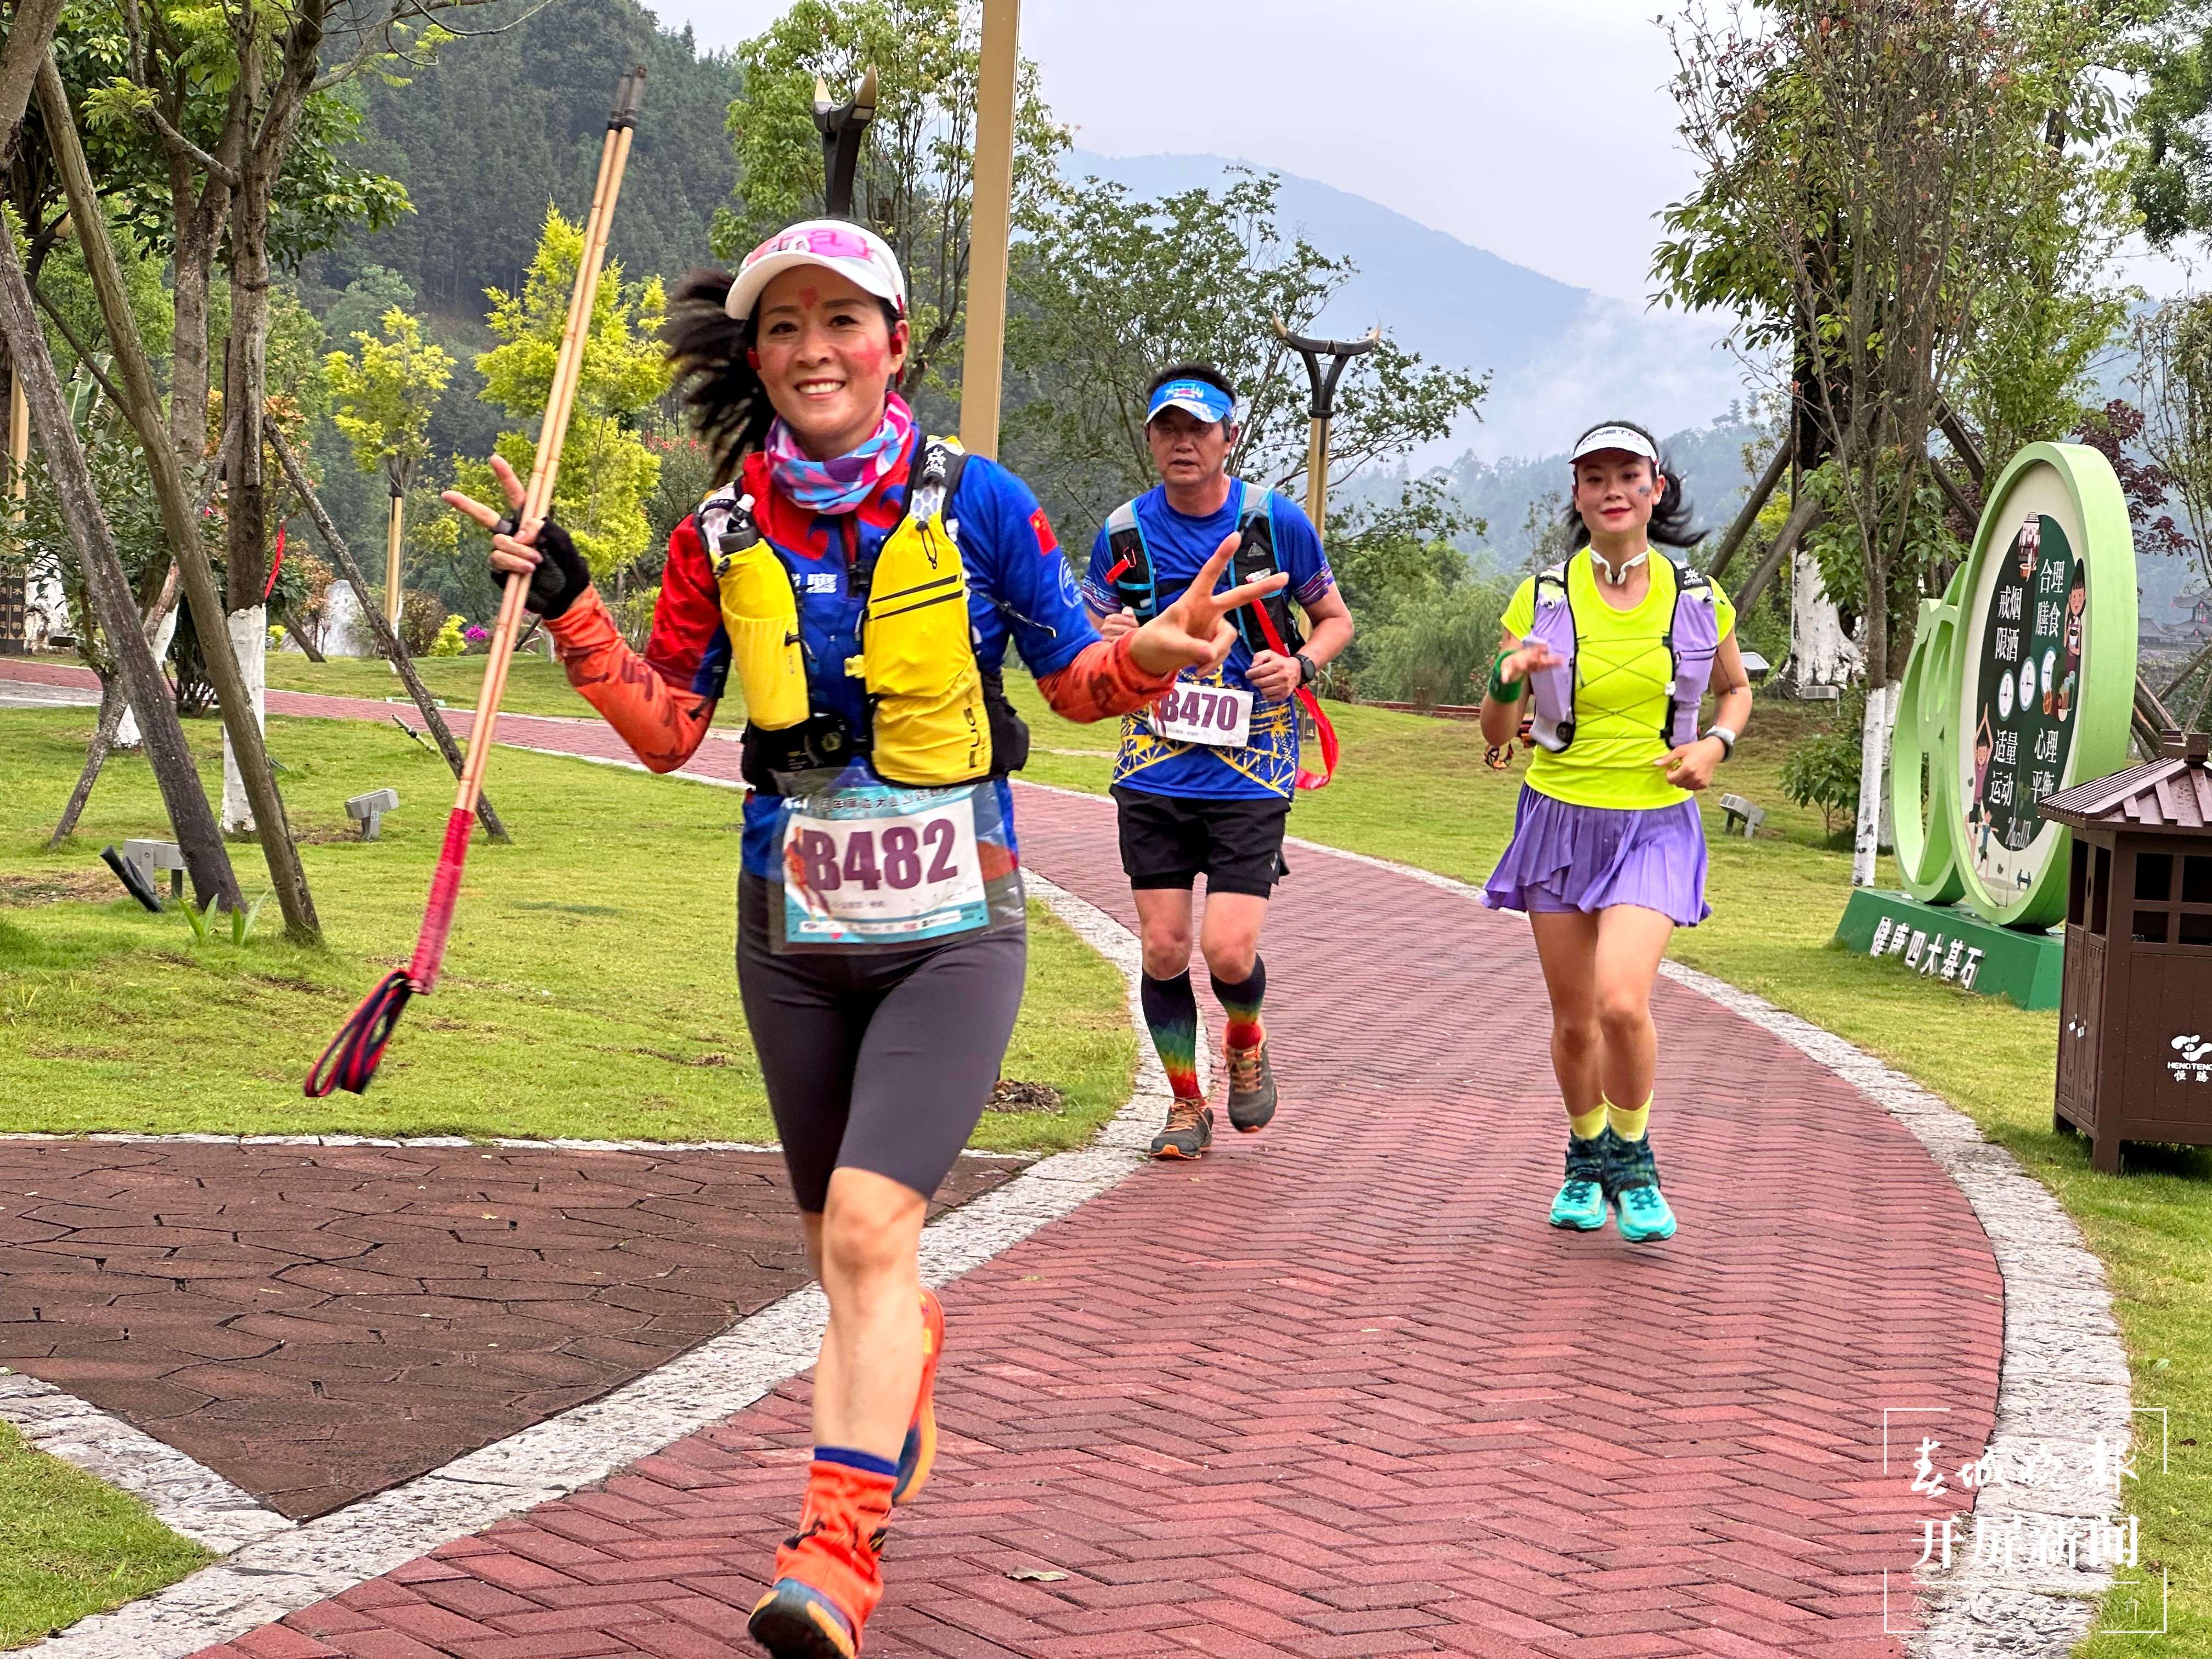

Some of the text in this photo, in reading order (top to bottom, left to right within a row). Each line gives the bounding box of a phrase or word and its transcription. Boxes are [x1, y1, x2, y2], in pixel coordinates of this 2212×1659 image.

[2040, 558, 2065, 594] 合理
[1997, 584, 2023, 620] 戒烟
[2035, 600, 2061, 638] 膳食
[1994, 627, 2019, 662] 限酒
[1159, 688, 1239, 731] B470
[1993, 728, 2018, 765] 适量
[2034, 727, 2058, 764] 心理
[1989, 770, 2014, 807] 运动
[2030, 770, 2055, 804] 平衡
[799, 818, 958, 891] B482
[1869, 916, 1983, 990] 健康四大基石
